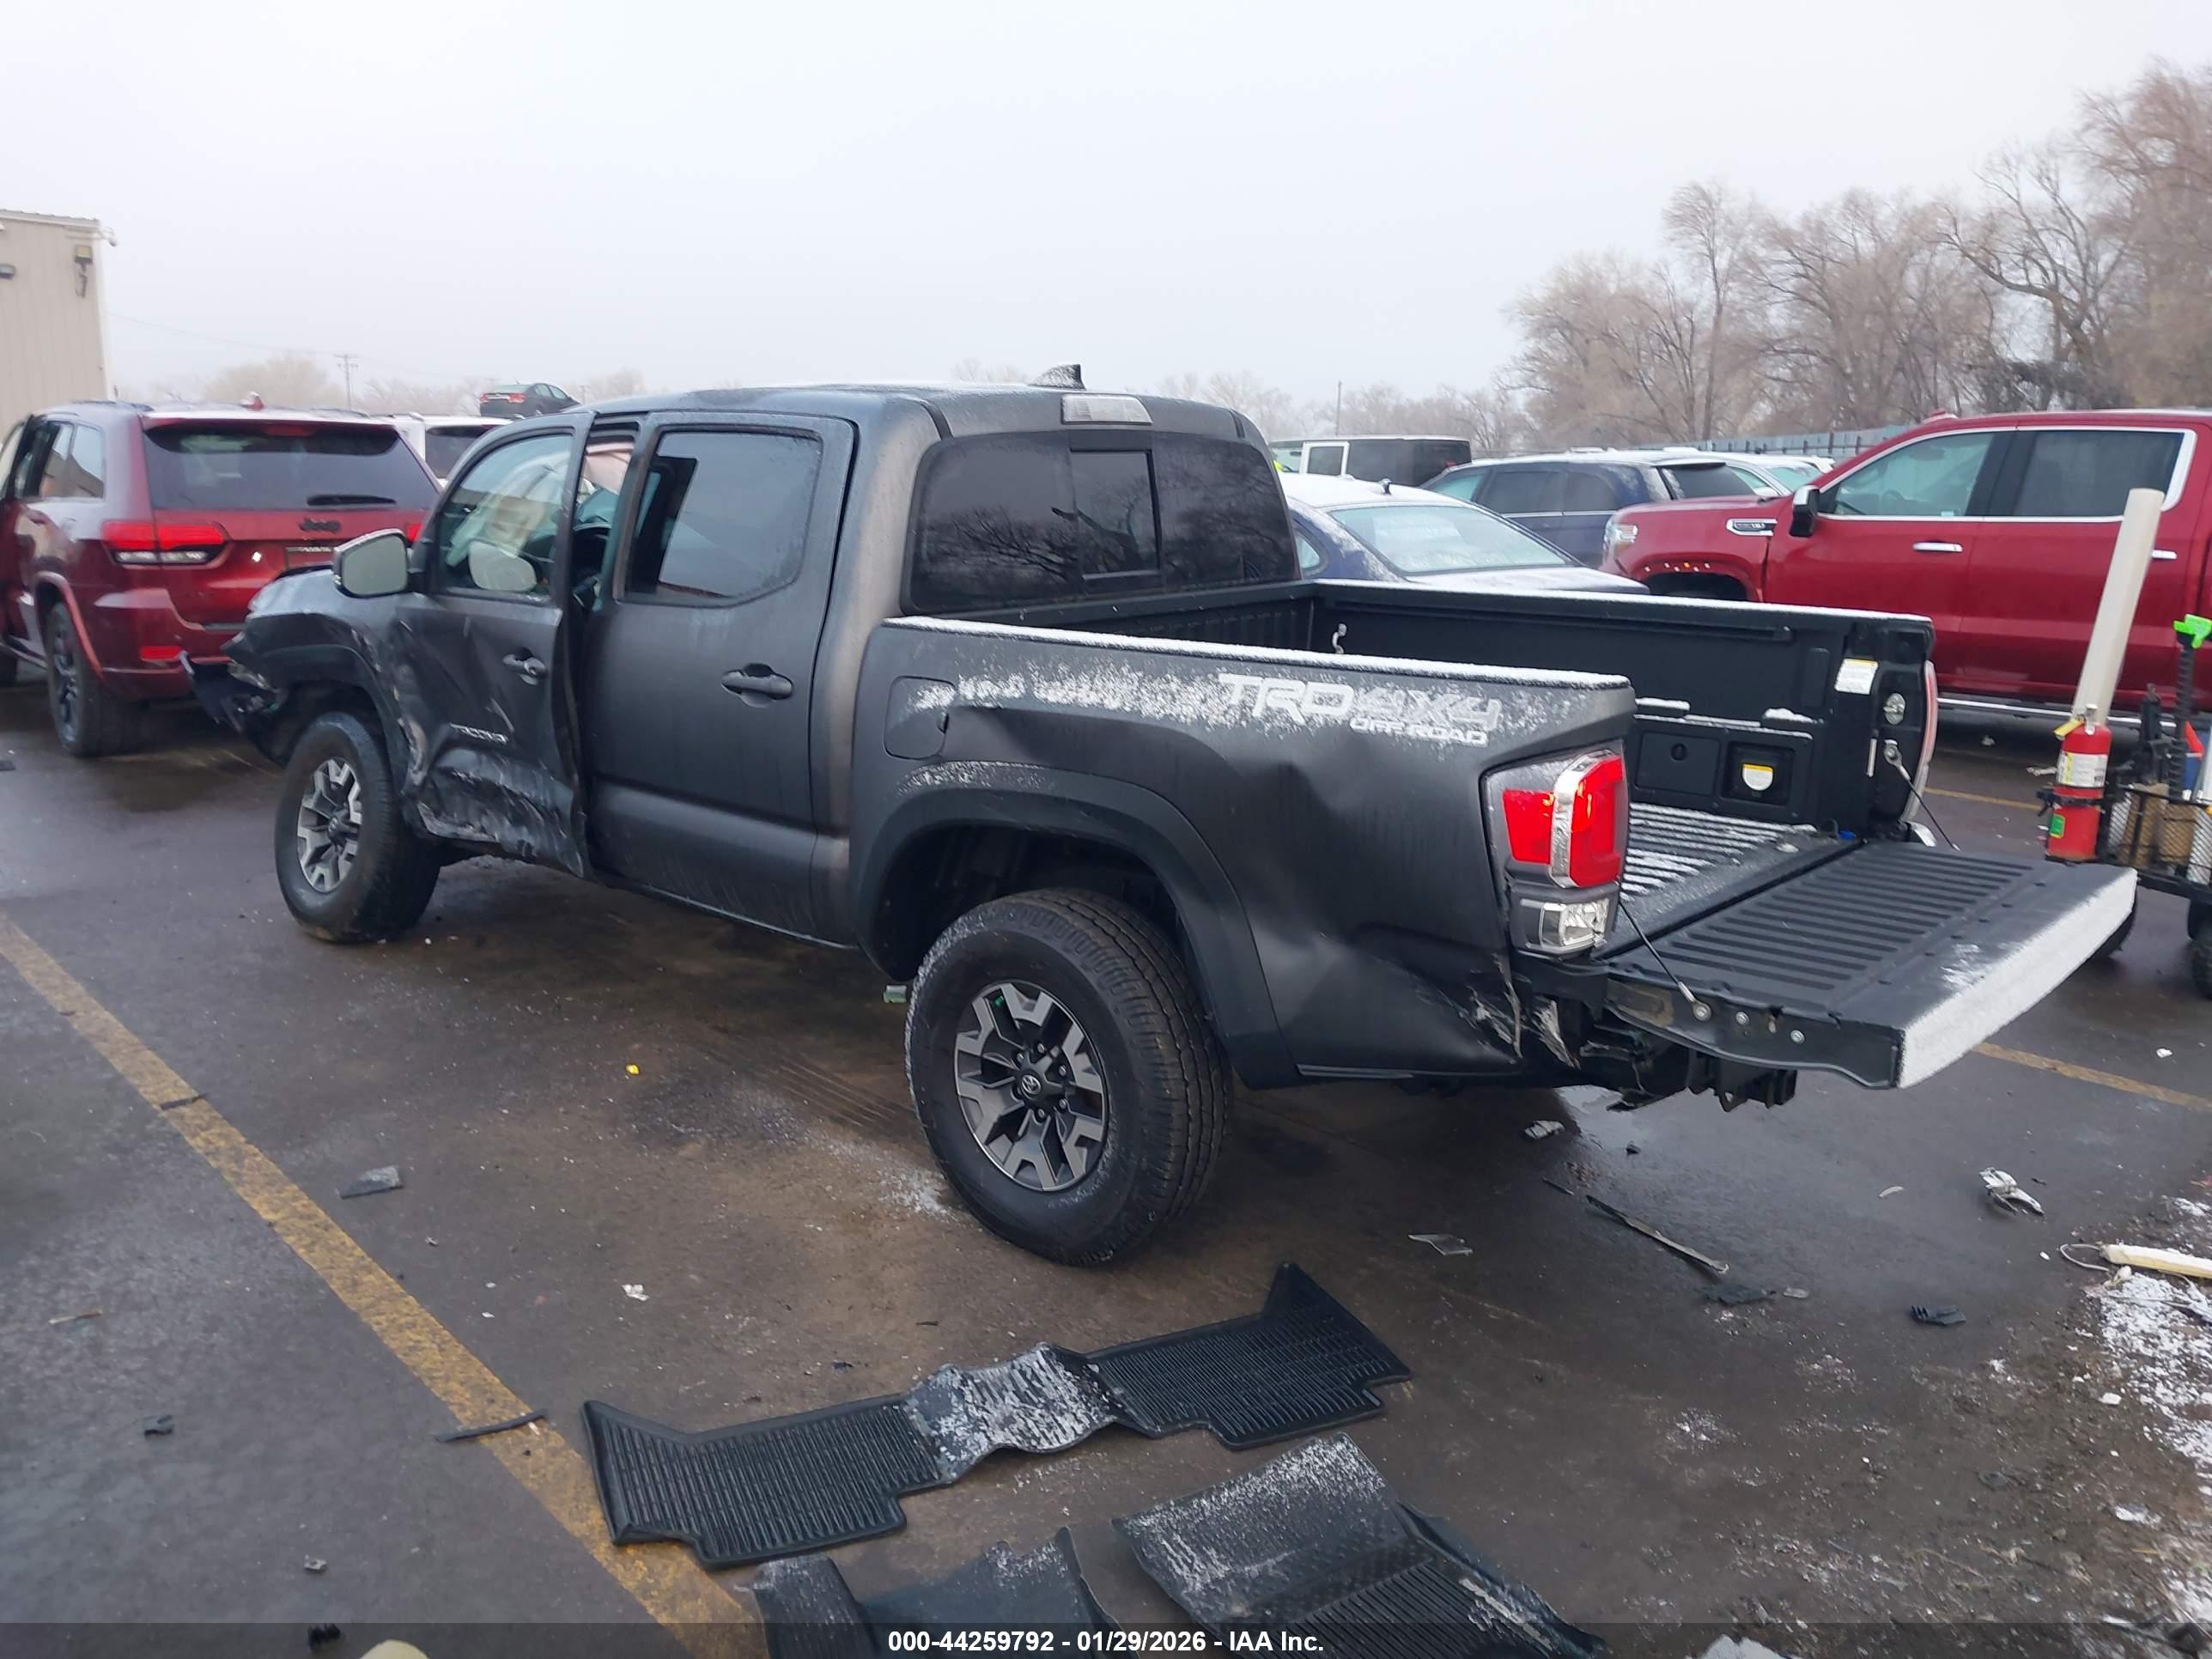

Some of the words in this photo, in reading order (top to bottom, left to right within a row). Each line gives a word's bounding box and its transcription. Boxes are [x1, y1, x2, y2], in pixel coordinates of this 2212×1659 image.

[1218, 672, 1355, 726] TRD
[1349, 717, 1406, 736] OFF
[1406, 724, 1488, 748] ROAD
